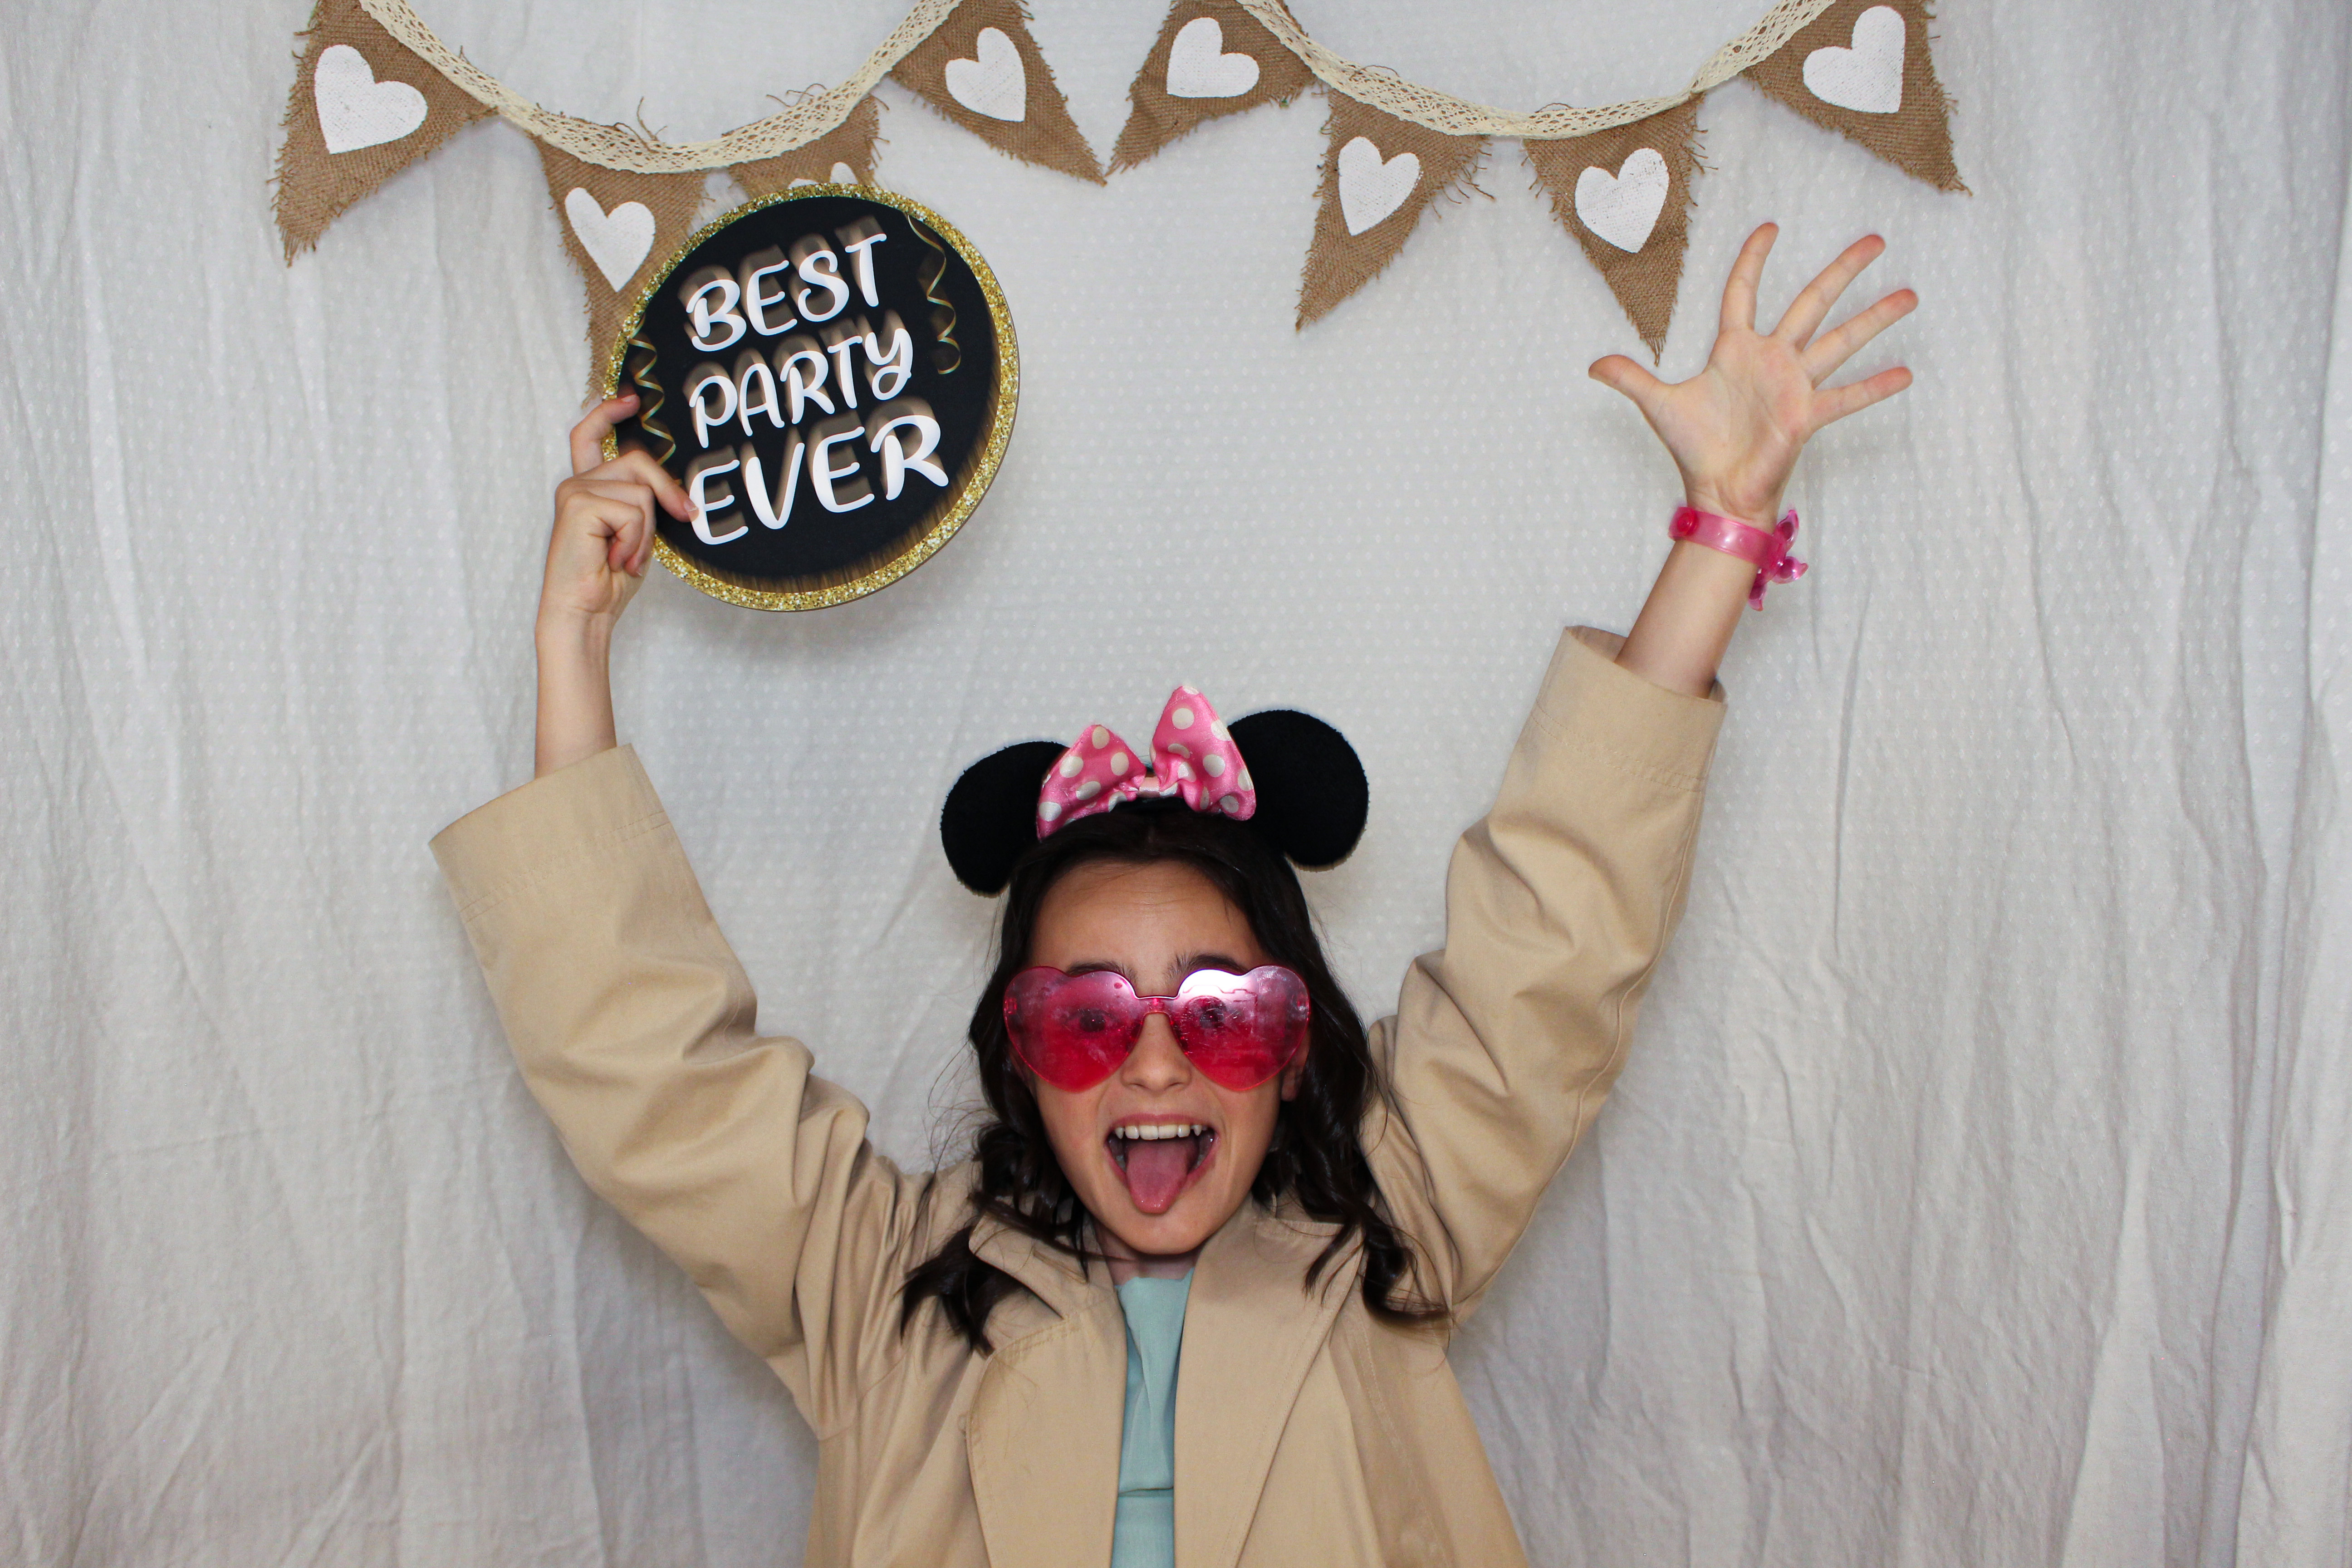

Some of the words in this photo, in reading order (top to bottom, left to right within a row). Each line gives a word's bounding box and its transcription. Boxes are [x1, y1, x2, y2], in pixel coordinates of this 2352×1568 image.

[686, 233, 887, 352] BEST
[689, 328, 913, 448] PARTY
[689, 414, 949, 545] EVER
